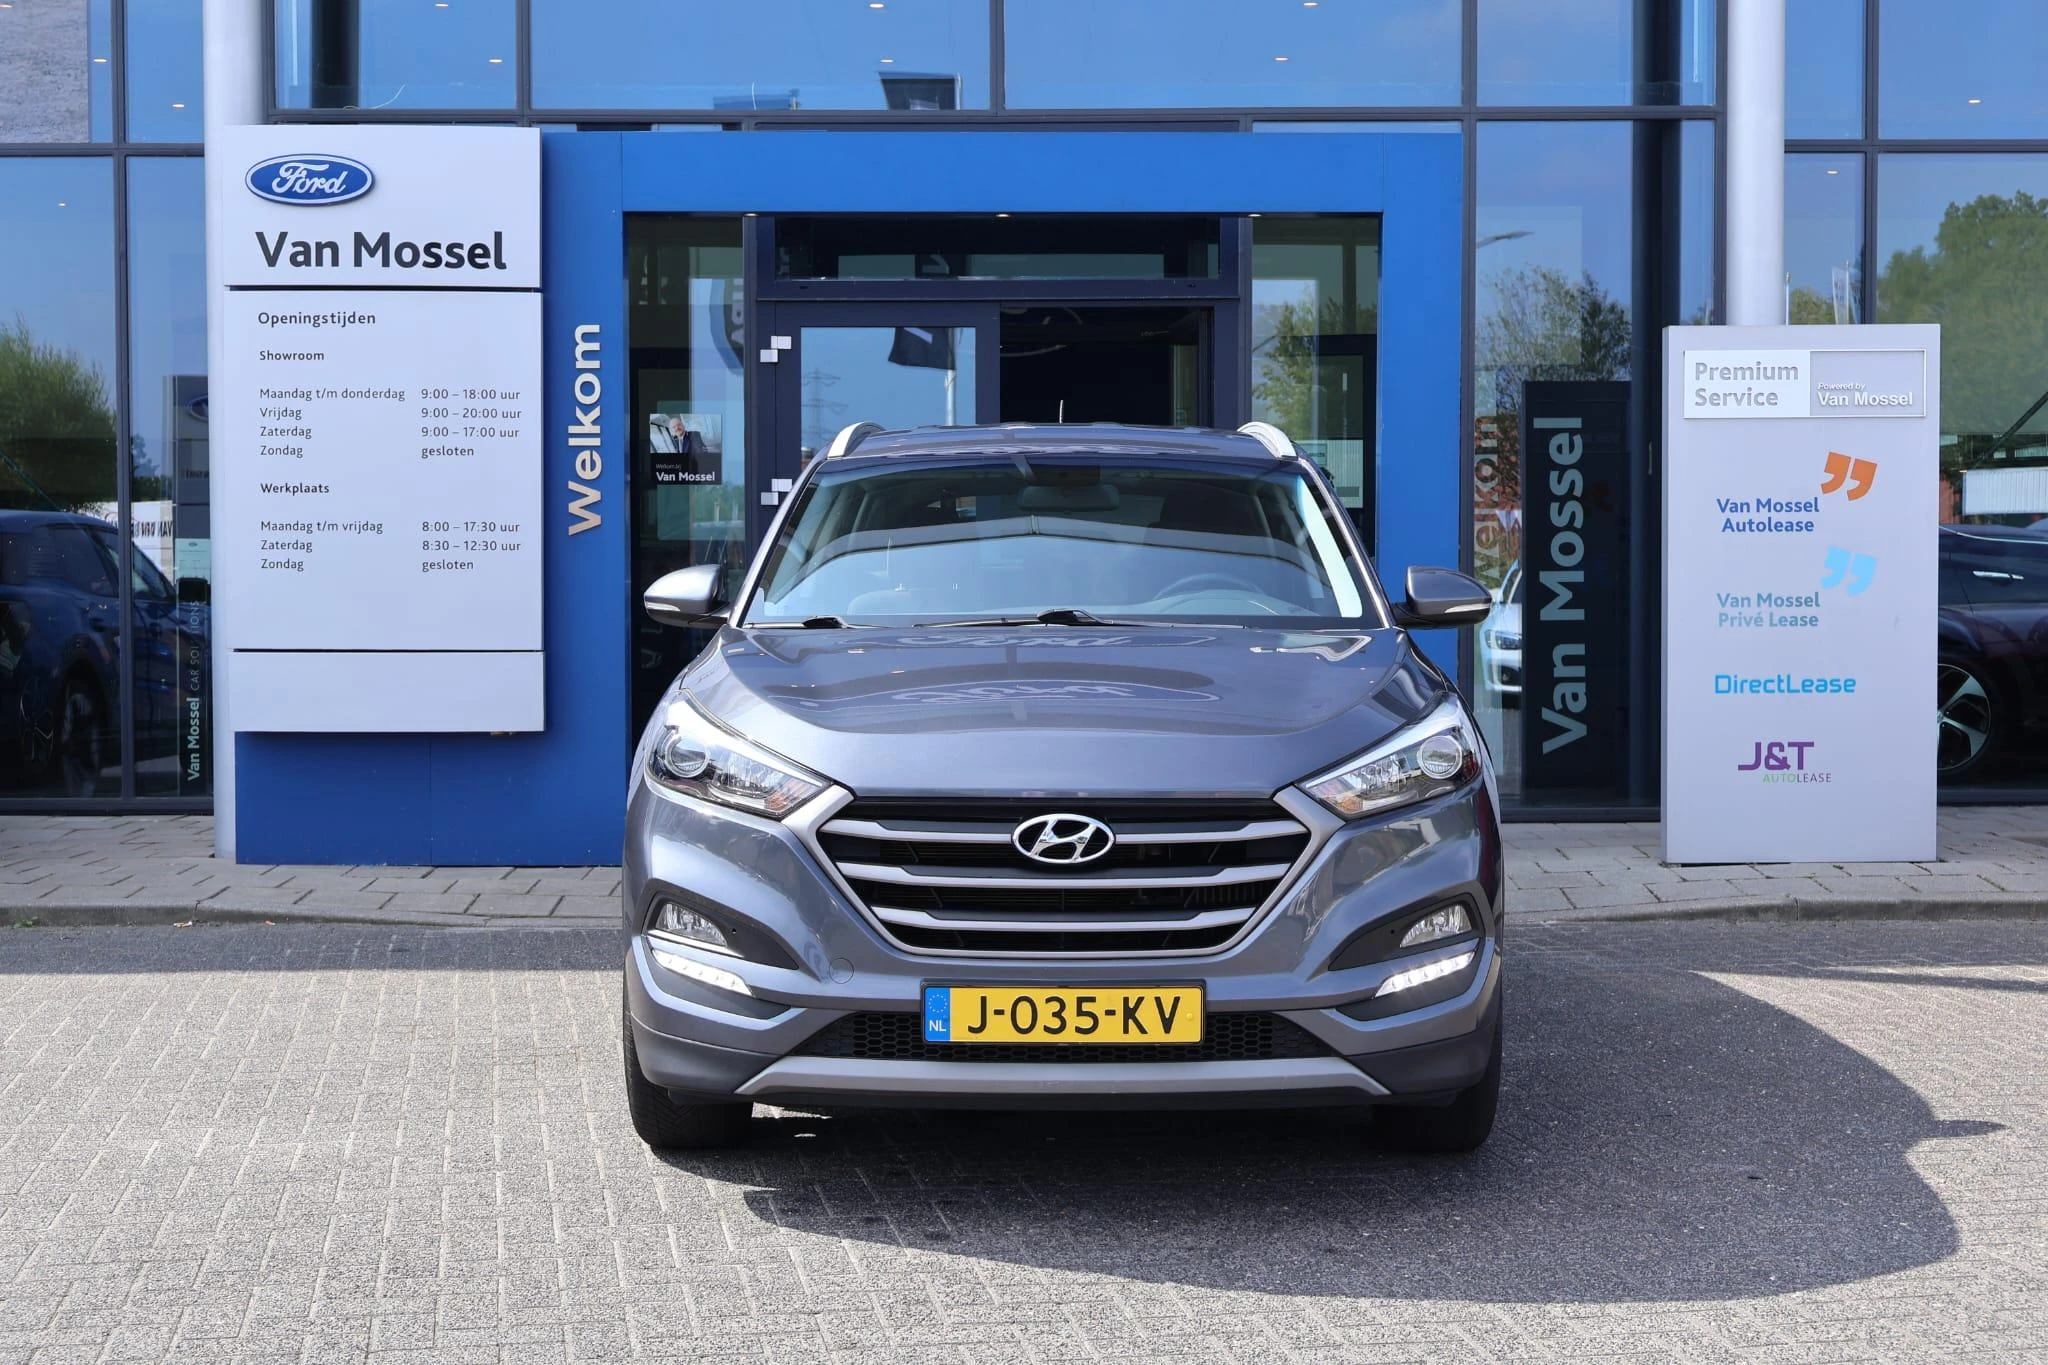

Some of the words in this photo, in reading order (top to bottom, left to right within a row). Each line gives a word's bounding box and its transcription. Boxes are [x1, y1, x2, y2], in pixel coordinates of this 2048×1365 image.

[271, 163, 349, 194] Ford
[255, 231, 340, 268] Van
[353, 231, 507, 270] Mossel
[258, 312, 375, 328] Openingstijden
[260, 350, 324, 360] Showroom
[1694, 362, 1799, 381] Premium
[260, 388, 312, 401] Maandag
[316, 388, 337, 398] t/m
[342, 388, 405, 401] donderdag
[421, 389, 448, 399] 9:00
[463, 389, 496, 399] 18:00
[1816, 382, 1855, 391] Powered
[1854, 383, 1866, 392] by
[1694, 387, 1779, 407] Service
[1817, 392, 1850, 407] Van
[1854, 391, 1913, 406] Mossel
[260, 407, 301, 420] Vrijdag
[422, 408, 448, 417] 9:00
[463, 408, 497, 418] 20:00
[261, 426, 311, 439] Zaterdag
[422, 427, 448, 436] 9:00
[464, 427, 495, 437] 17:00
[568, 324, 602, 536] Welkom
[261, 445, 302, 458] Zondag
[422, 446, 473, 458] gesloten
[656, 472, 675, 481] Van
[678, 472, 715, 481] Mossel
[261, 483, 329, 496] Werkplaats
[1717, 499, 1750, 513] Van
[1757, 497, 1819, 512] Mossel
[1533, 417, 1585, 621] Mossel
[1722, 517, 1814, 532] Autolease
[261, 521, 313, 534] Maandag
[317, 521, 338, 530] t/m
[343, 521, 383, 534] vrijdag
[423, 522, 449, 531] 8:00
[464, 522, 496, 532] 17:30
[261, 540, 312, 553] Zaterdag
[423, 541, 449, 550] 8:30
[464, 541, 497, 550] 12:30
[261, 558, 303, 572] Zondag
[423, 560, 473, 572] gesloten
[1717, 593, 1751, 608] Van
[1757, 592, 1820, 607] Mossel
[1719, 612, 1763, 627] Privé
[1770, 612, 1819, 627] Lease
[189, 600, 200, 665] SOLTIONS
[190, 666, 200, 691] CAR
[1715, 674, 1856, 693] DirectLease
[1539, 644, 1588, 754] Van
[186, 697, 200, 748] Mossel
[1738, 742, 1814, 770] J&T
[187, 753, 200, 781] Van
[1763, 774, 1832, 783] AUTOLEASE
[929, 1020, 947, 1032] NL
[967, 995, 1181, 1034] J-035-KV
